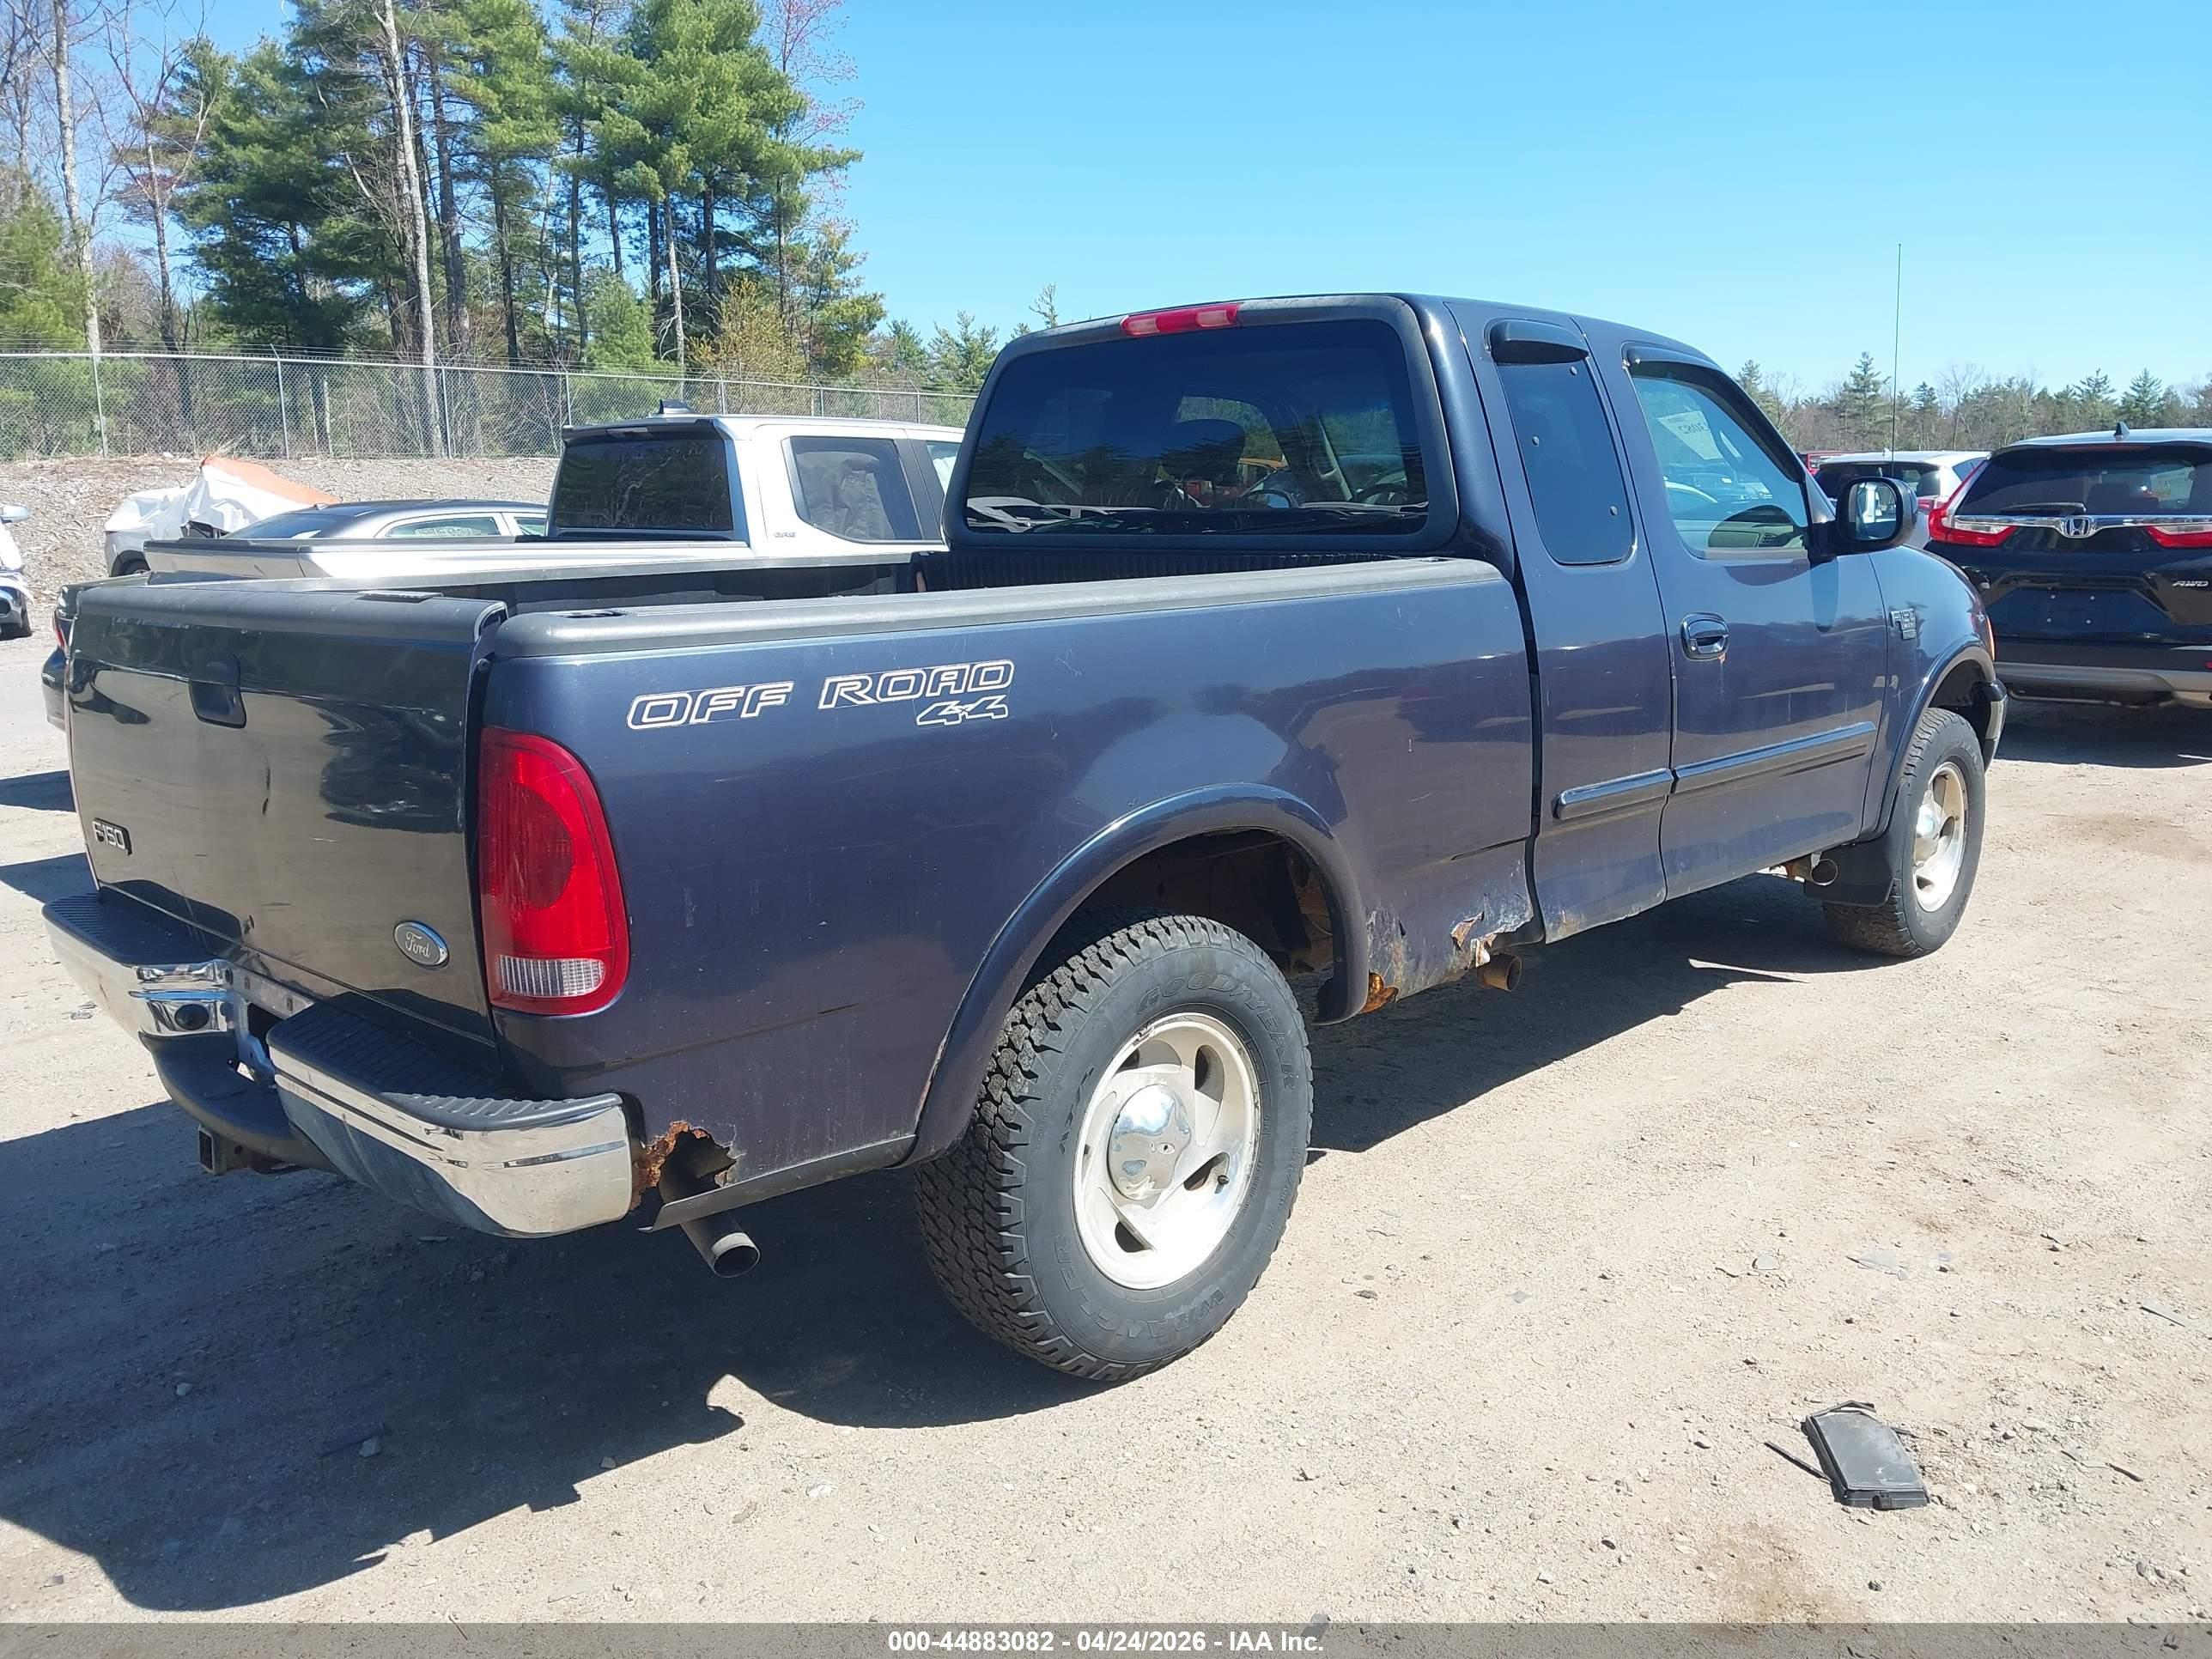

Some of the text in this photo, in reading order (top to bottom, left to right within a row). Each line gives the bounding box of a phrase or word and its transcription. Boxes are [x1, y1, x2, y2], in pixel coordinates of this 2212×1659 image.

[627, 659, 1015, 730] OFF ROAD
[404, 931, 431, 958] Ford
[1136, 972, 1299, 1091] GOODYEAR
[1053, 1233, 1225, 1340] WRANGLER
